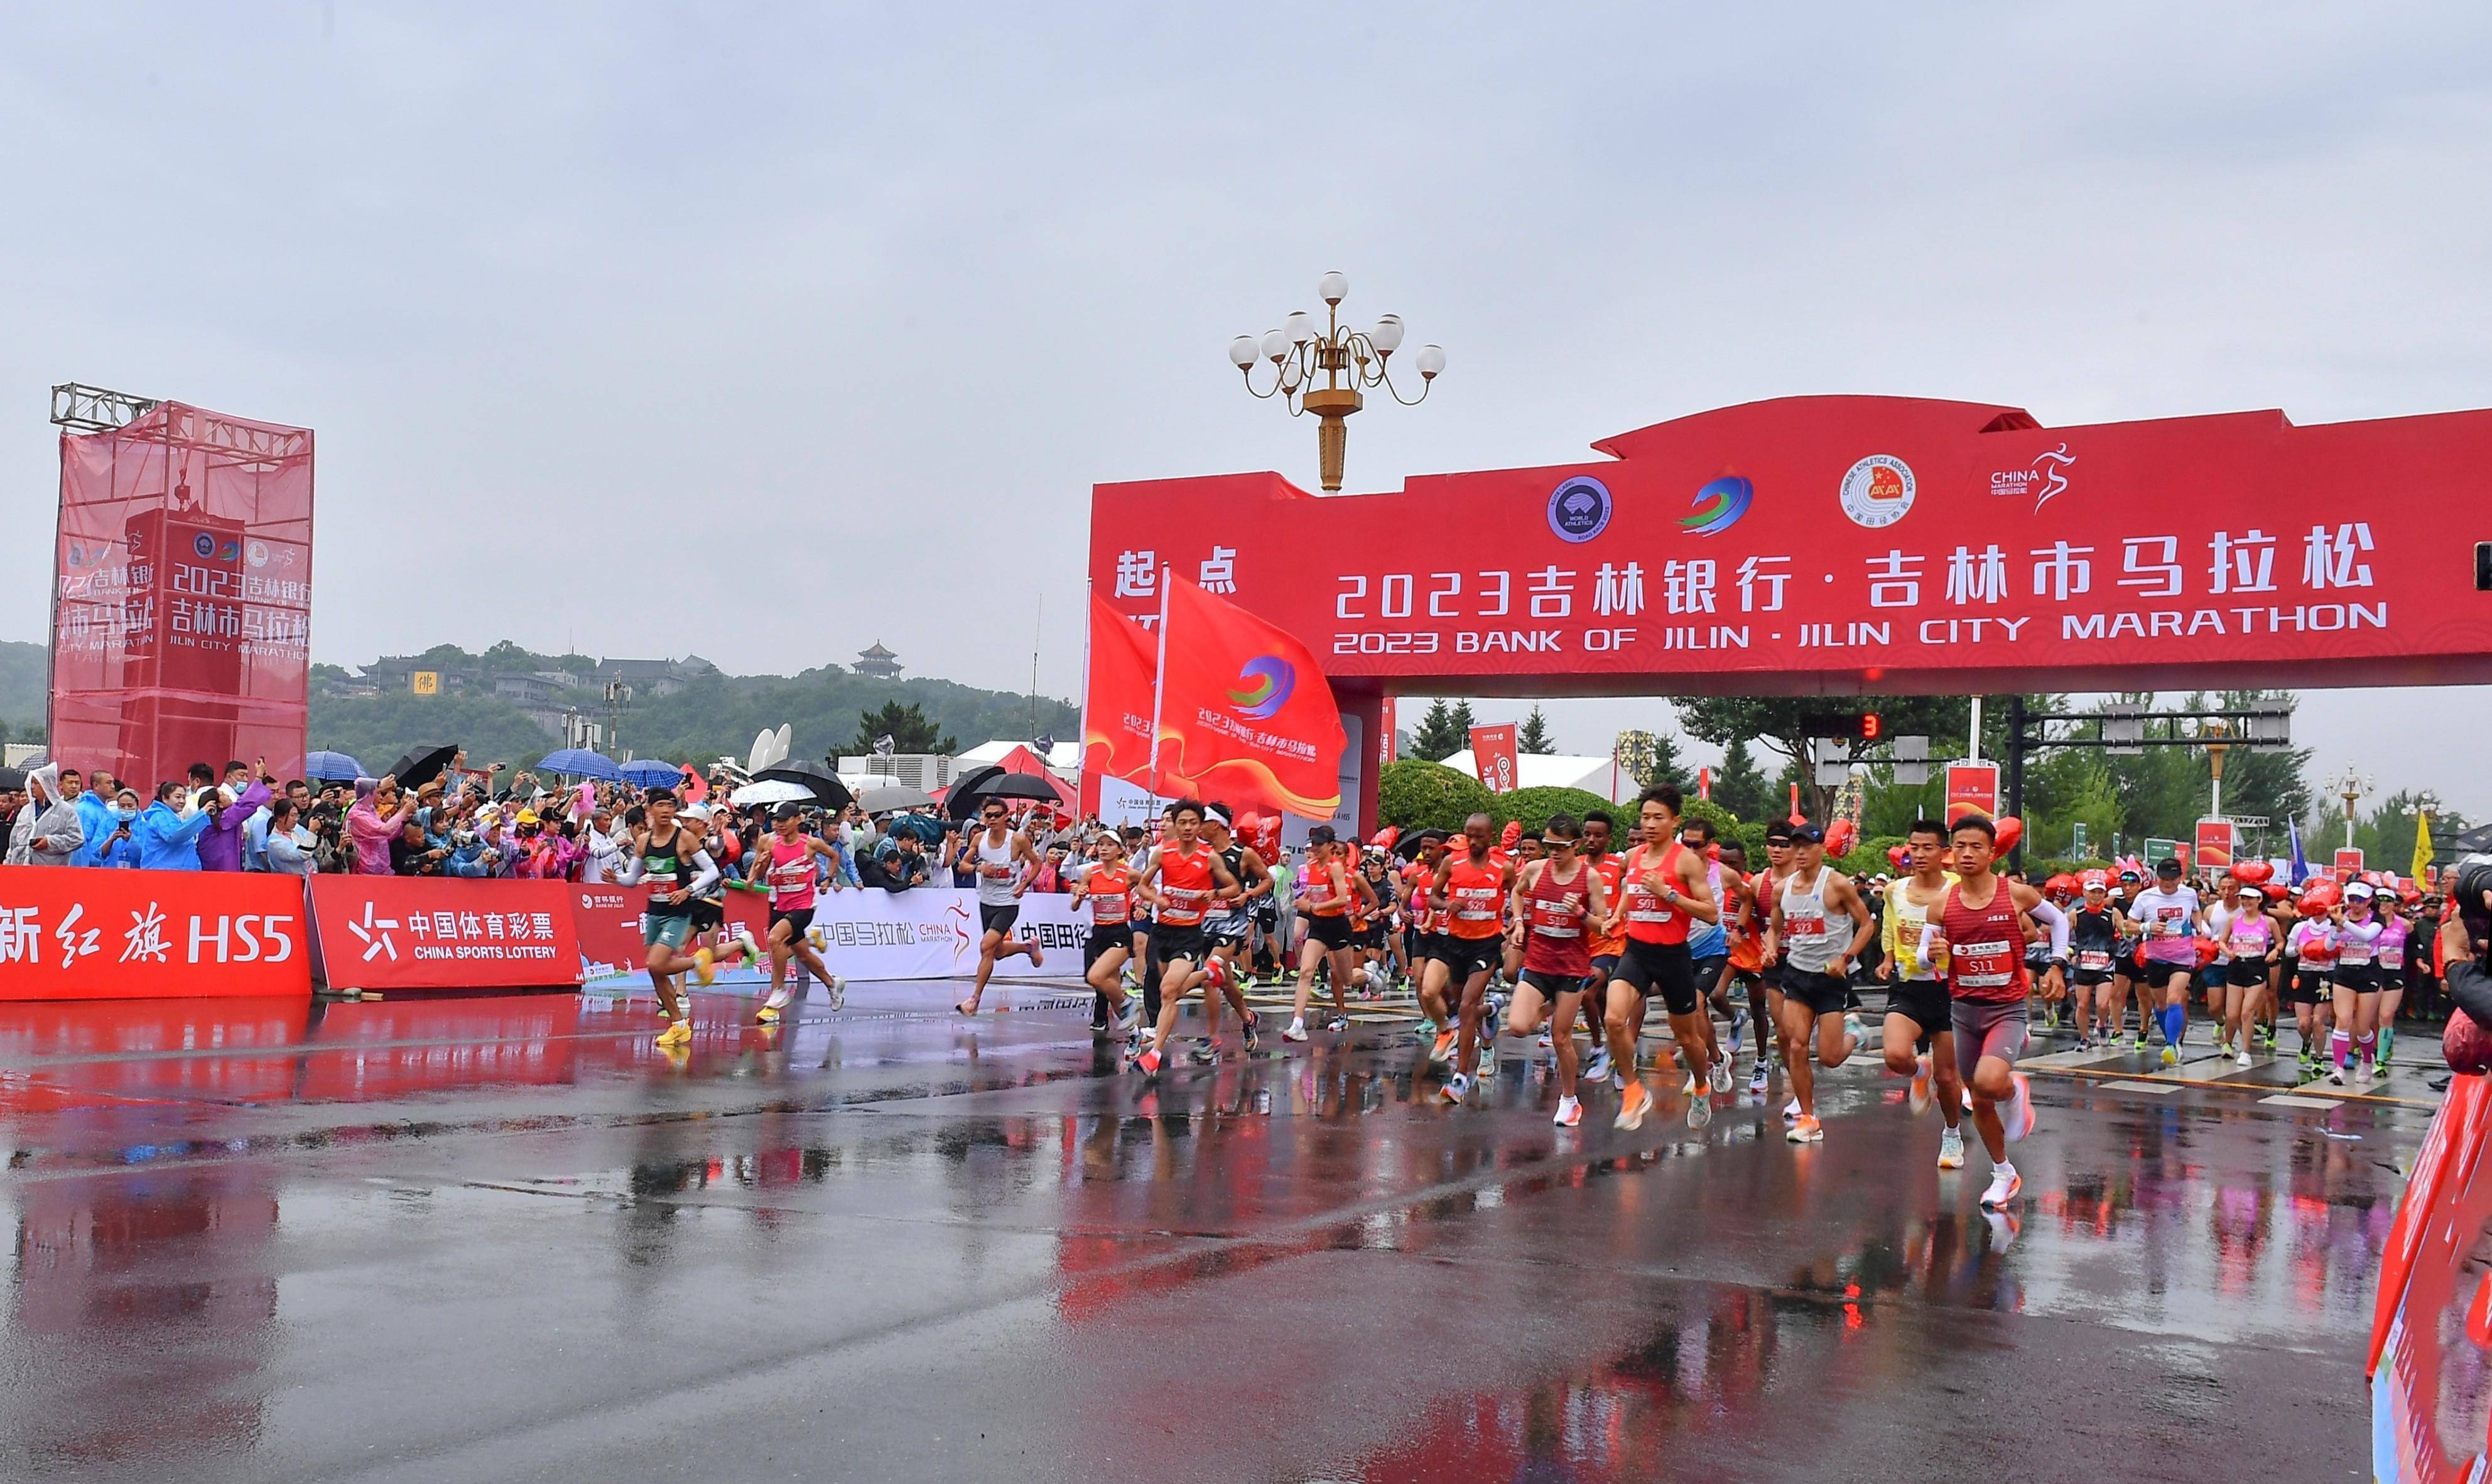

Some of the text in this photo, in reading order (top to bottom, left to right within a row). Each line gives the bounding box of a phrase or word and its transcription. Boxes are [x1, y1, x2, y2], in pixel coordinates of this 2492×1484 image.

[1991, 470, 2040, 484] CHINA
[174, 563, 247, 601] 2023
[1114, 545, 1237, 600] 起点
[1333, 632, 1439, 654] 2023
[1456, 630, 1562, 653] BANK
[1584, 629, 1638, 651] OF
[1664, 626, 1750, 650] JILIN
[1798, 621, 1890, 647] JILIN
[1919, 616, 2031, 644] CITY
[2061, 601, 2388, 641] MARATHON
[170, 634, 195, 647] JILIN
[200, 639, 231, 652] CITY
[416, 673, 433, 693] 佛
[1863, 715, 1877, 736] 3
[1637, 899, 1657, 909] S01
[0, 901, 294, 969] 新红旗 HS5
[408, 910, 554, 941] 中国体育彩票
[816, 922, 916, 946] 中国马拉松
[919, 924, 951, 936] CHINA
[414, 945, 557, 960] CHINA SPORTS LOTTERY
[1969, 960, 1996, 972] S11
